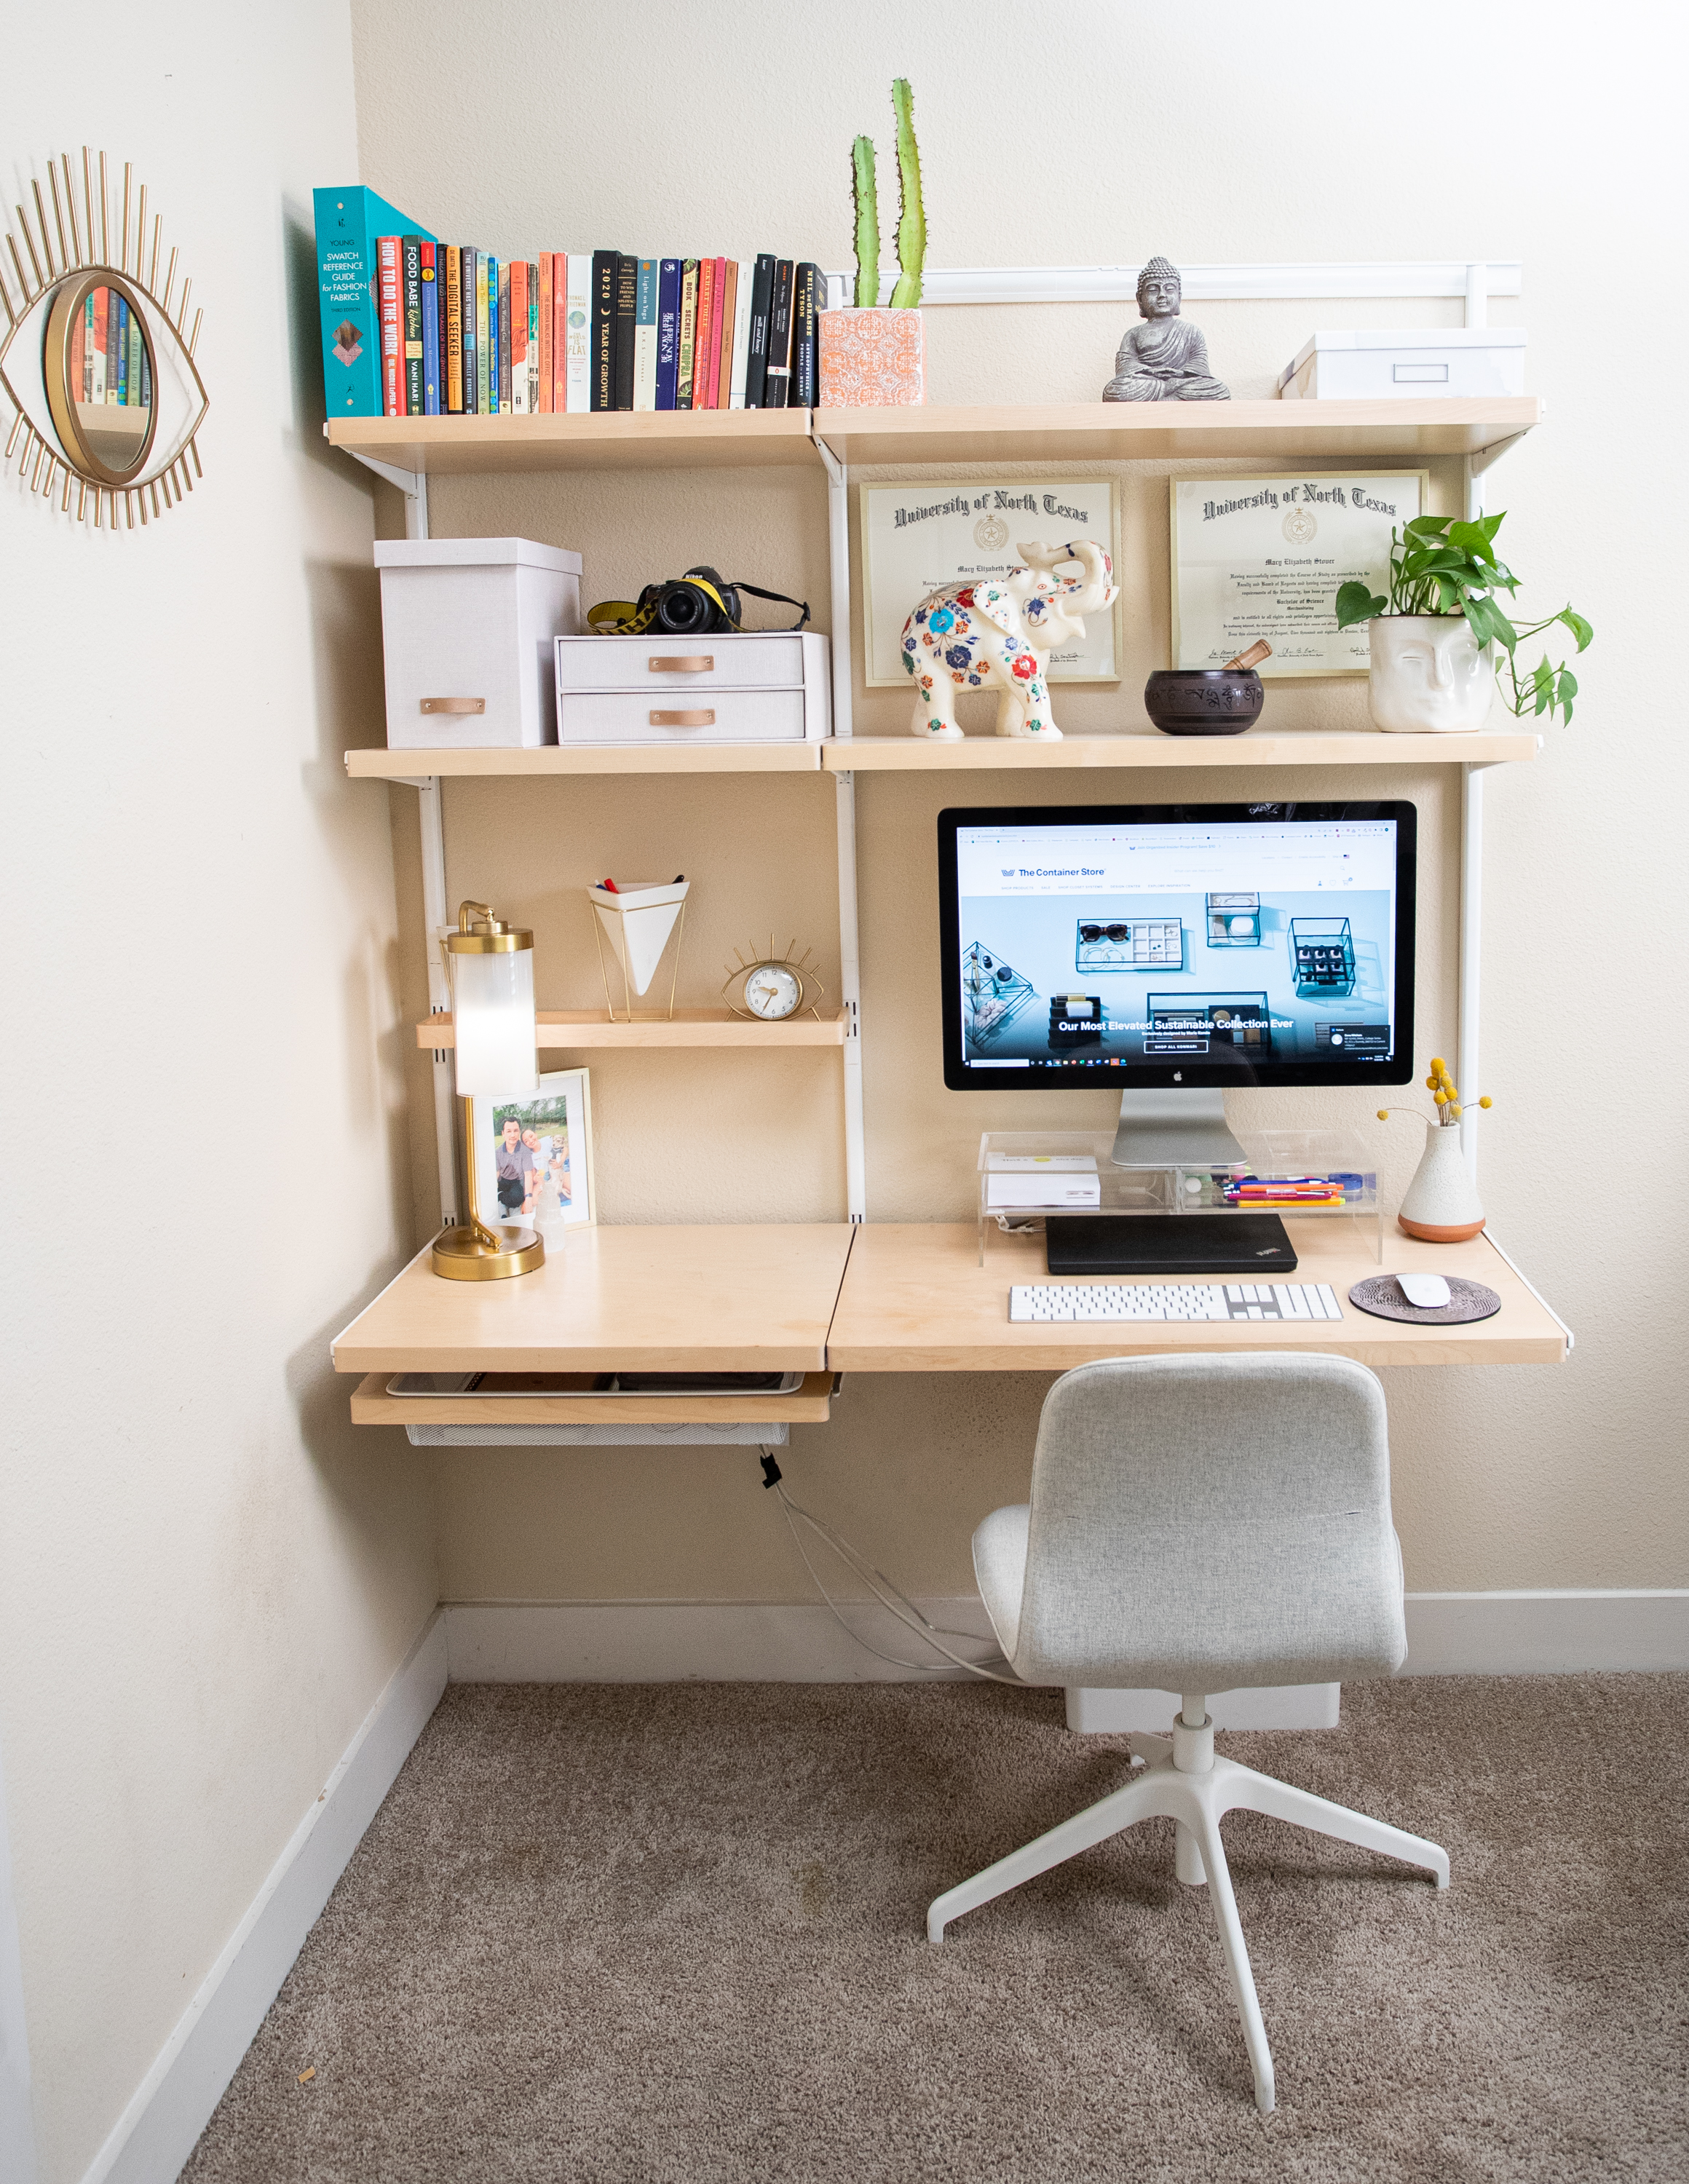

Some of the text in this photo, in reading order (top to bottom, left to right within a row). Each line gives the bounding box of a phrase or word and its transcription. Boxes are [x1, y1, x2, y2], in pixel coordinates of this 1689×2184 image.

[327, 252, 359, 261] SWATCH
[323, 262, 363, 272] REFERENCE
[332, 273, 356, 281] GUIDE
[448, 269, 456, 282] THE
[322, 282, 367, 292] for FASHION
[602, 268, 611, 298] 2020
[330, 293, 360, 301] FABRICS
[381, 242, 398, 356] HOW TO DO THE WORK
[407, 246, 420, 339] FOOD BABE kitchen
[643, 295, 647, 304] on
[448, 284, 459, 319] DIGITAL
[667, 312, 674, 322] BE
[684, 309, 692, 339] SECRETS
[448, 322, 459, 356] SEEKER
[567, 345, 586, 355] FLAT
[665, 345, 673, 363] NOW
[600, 323, 609, 408] YEAR OF GROWTH
[681, 344, 692, 377] CHOPRA
[388, 368, 396, 387] NICOLE
[411, 360, 419, 381] VANI
[480, 371, 486, 381] OF
[894, 490, 1088, 529] University of North Texas
[1203, 483, 1396, 522] University of North Texas
[957, 565, 975, 573] Macy
[976, 564, 1005, 573] Elizabeth
[1265, 557, 1335, 566] Macy Elizabeth Stover
[1018, 868, 1105, 877] The Container Store
[1058, 1018, 1294, 1032] Our Most Elevated Sustainable Collection Ever
